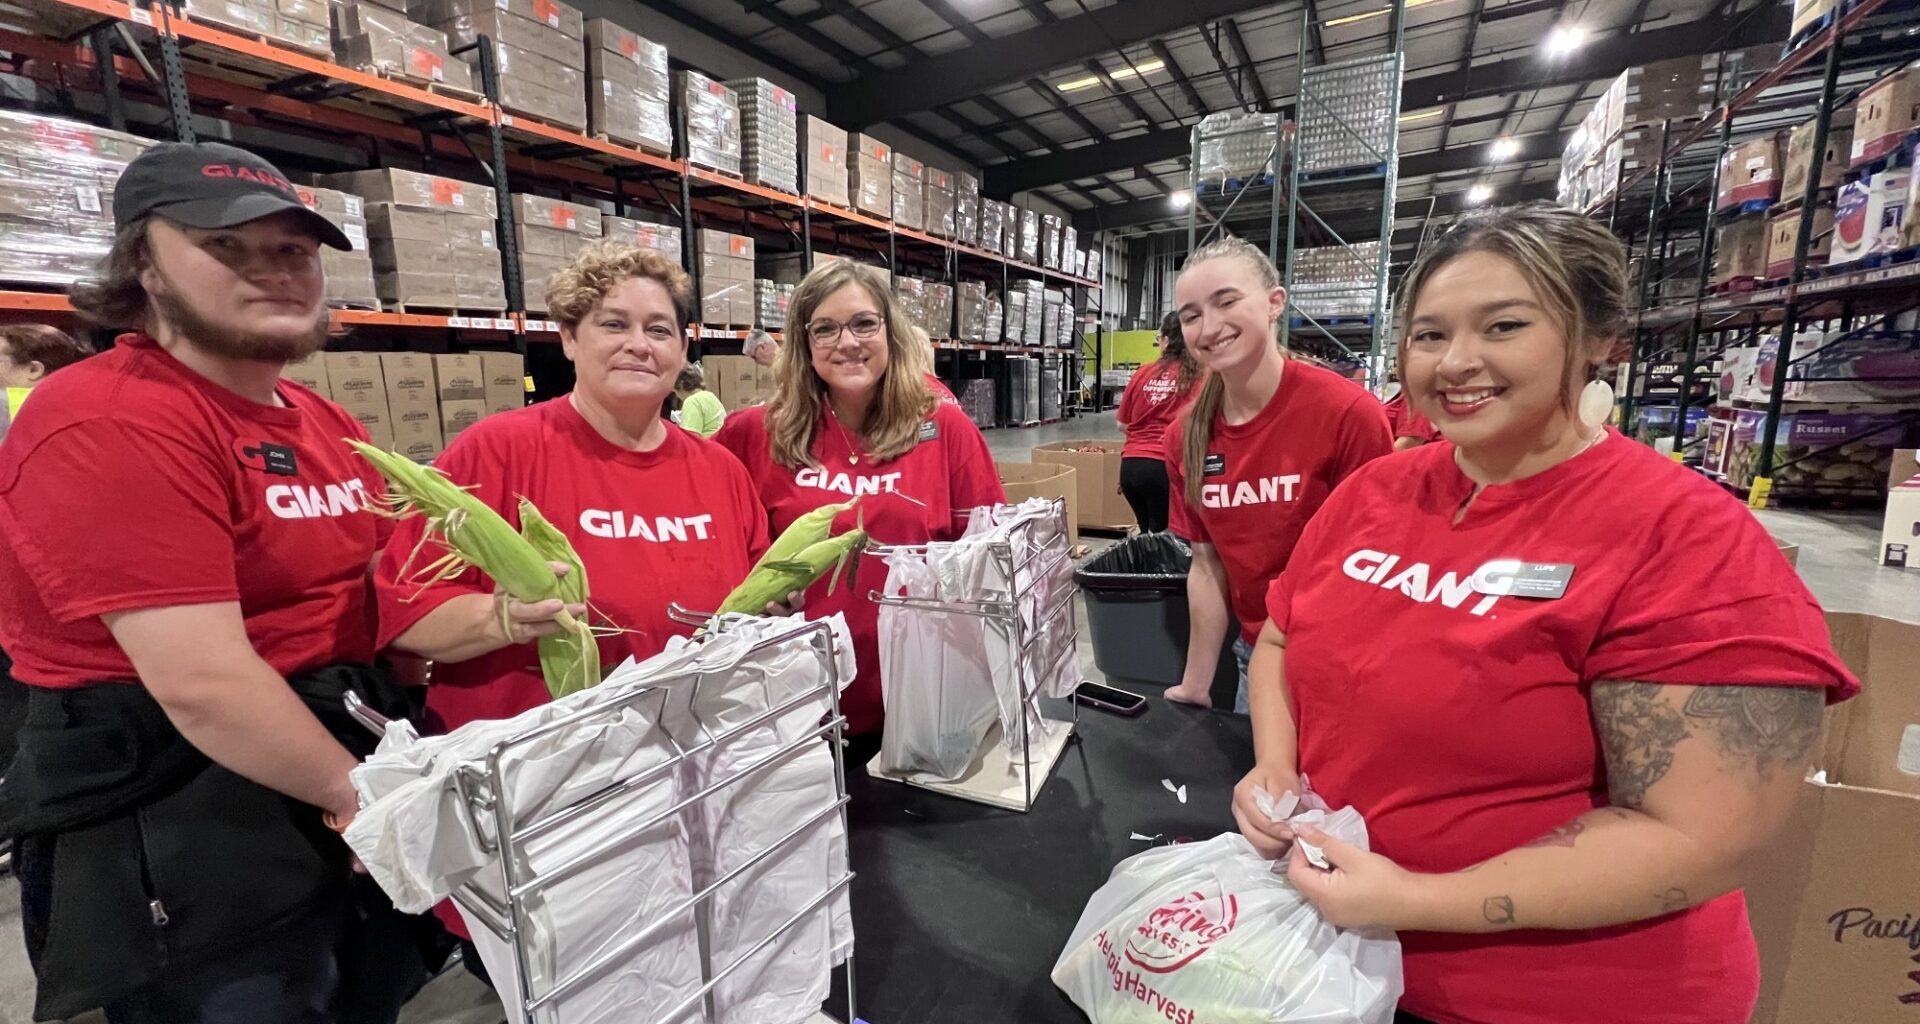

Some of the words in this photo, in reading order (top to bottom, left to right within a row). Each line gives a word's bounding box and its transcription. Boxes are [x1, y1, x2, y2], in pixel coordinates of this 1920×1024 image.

[201, 164, 290, 192] GIANT
[1796, 424, 1847, 434] Russet
[265, 477, 364, 519] GIANT
[795, 467, 902, 496] GIANT
[1201, 474, 1301, 509] GIANT
[579, 508, 712, 543] GIANT
[1124, 970, 1195, 1024] Harvest
